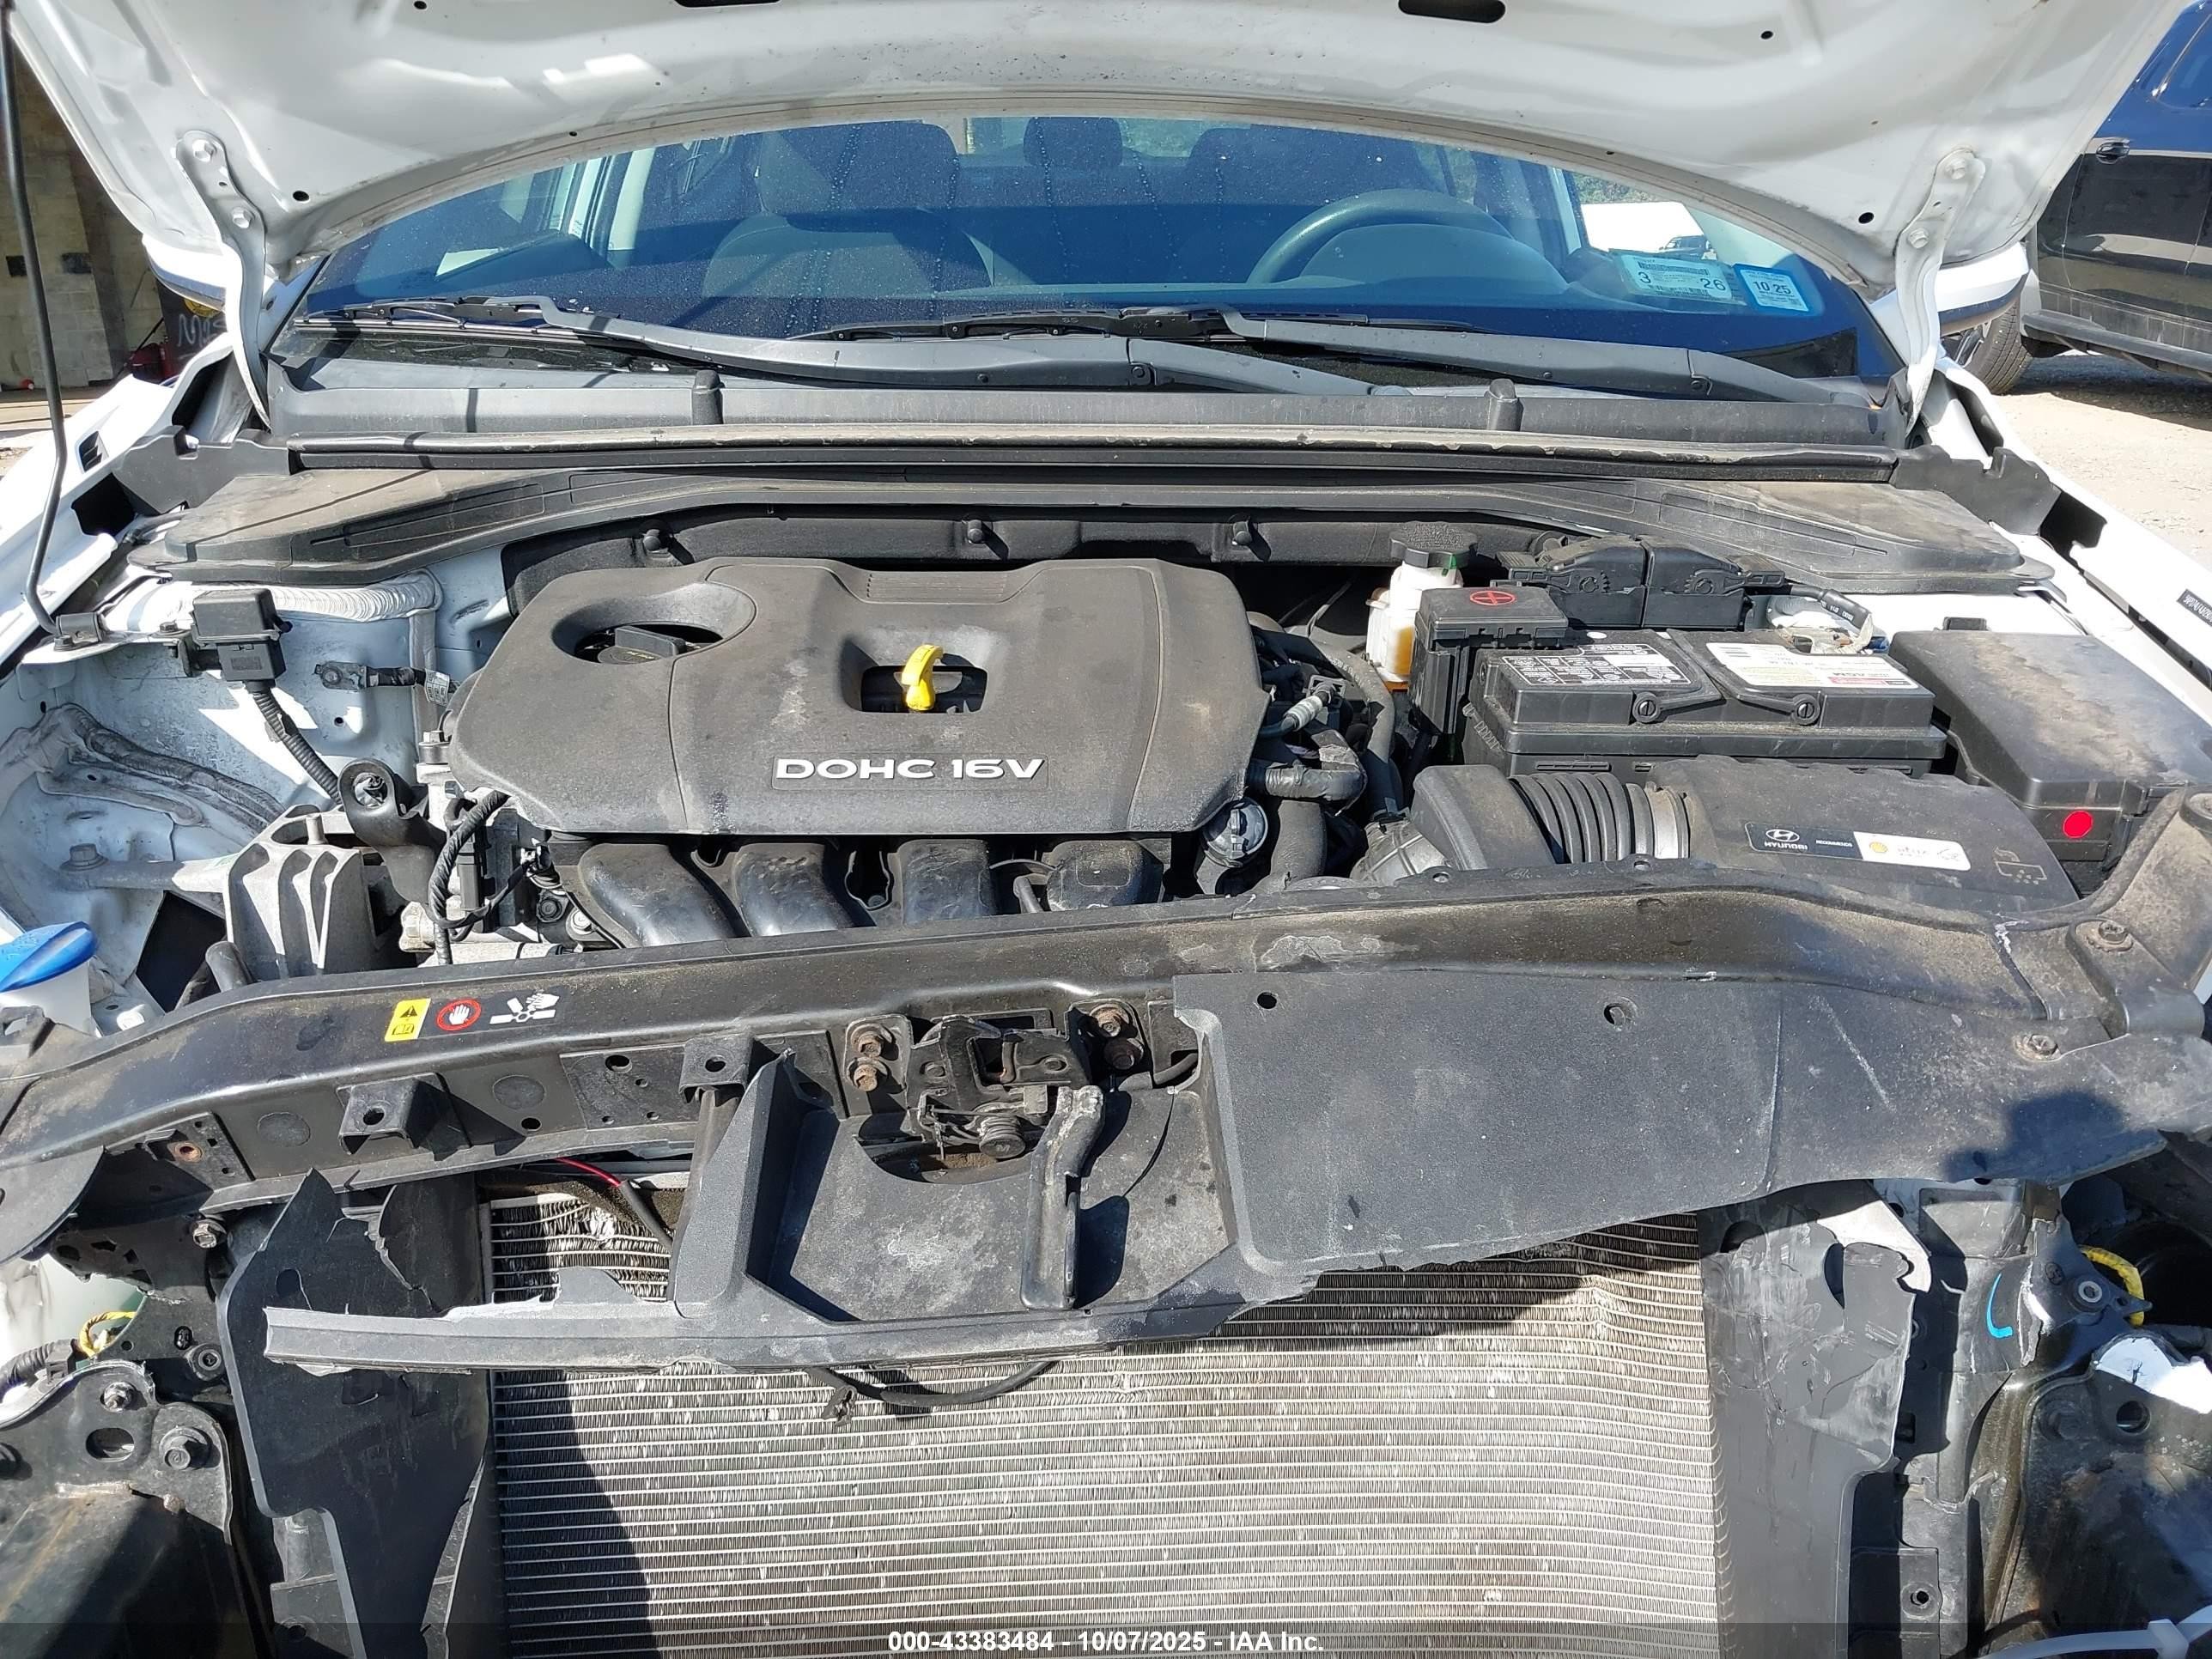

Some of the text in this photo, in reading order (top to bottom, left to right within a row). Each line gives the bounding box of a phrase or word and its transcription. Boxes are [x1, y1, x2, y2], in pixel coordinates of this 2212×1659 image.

[1638, 271, 1651, 284] 3
[1699, 277, 1726, 291] 26
[1753, 281, 1792, 295] 10 25
[775, 758, 1045, 780] DOHC 16V
[1764, 841, 1808, 851] HYUNDAI
